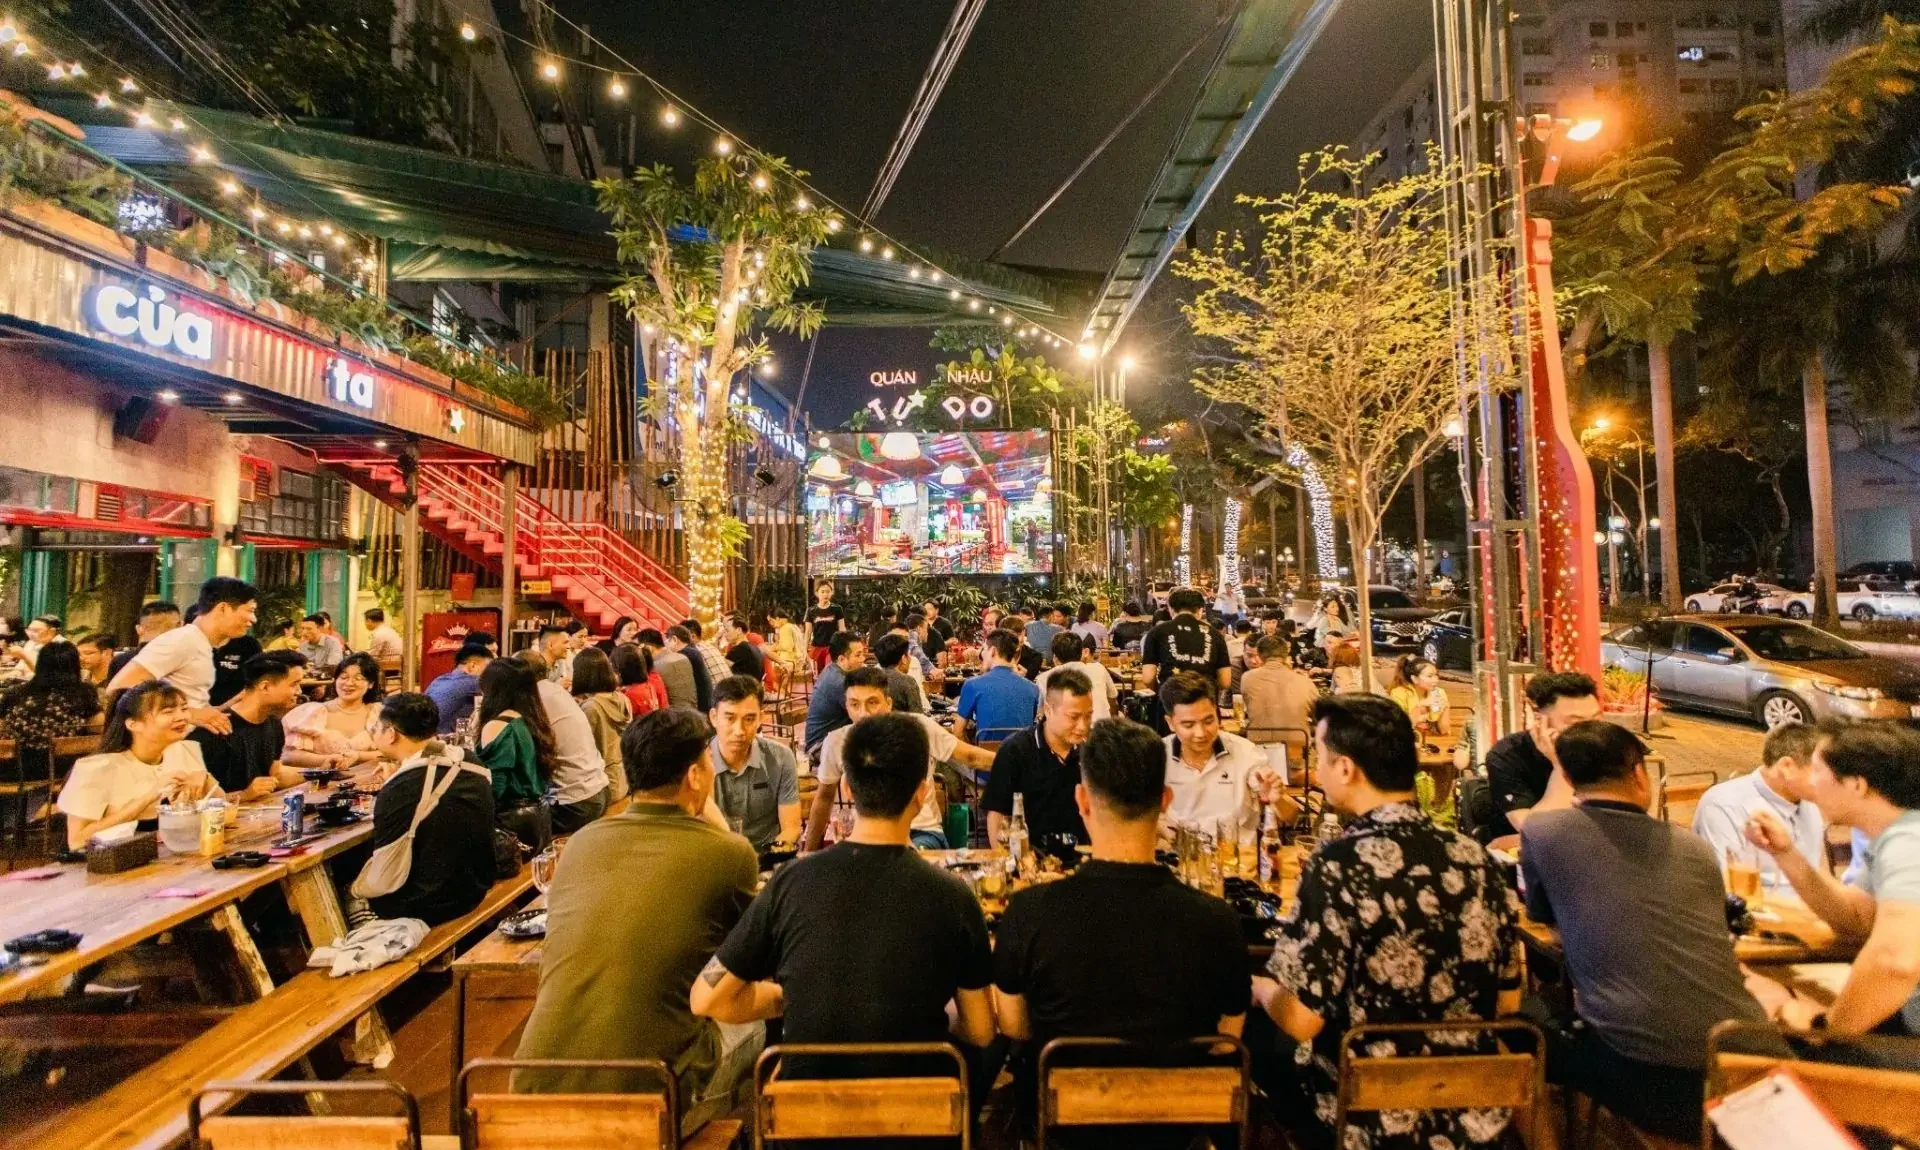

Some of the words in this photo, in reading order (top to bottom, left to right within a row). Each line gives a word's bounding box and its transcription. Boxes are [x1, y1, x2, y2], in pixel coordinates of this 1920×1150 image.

[96, 285, 213, 360] của
[333, 358, 374, 409] ta
[870, 369, 917, 387] QUÁN
[947, 368, 993, 385] NHẬU
[942, 396, 993, 420] DO
